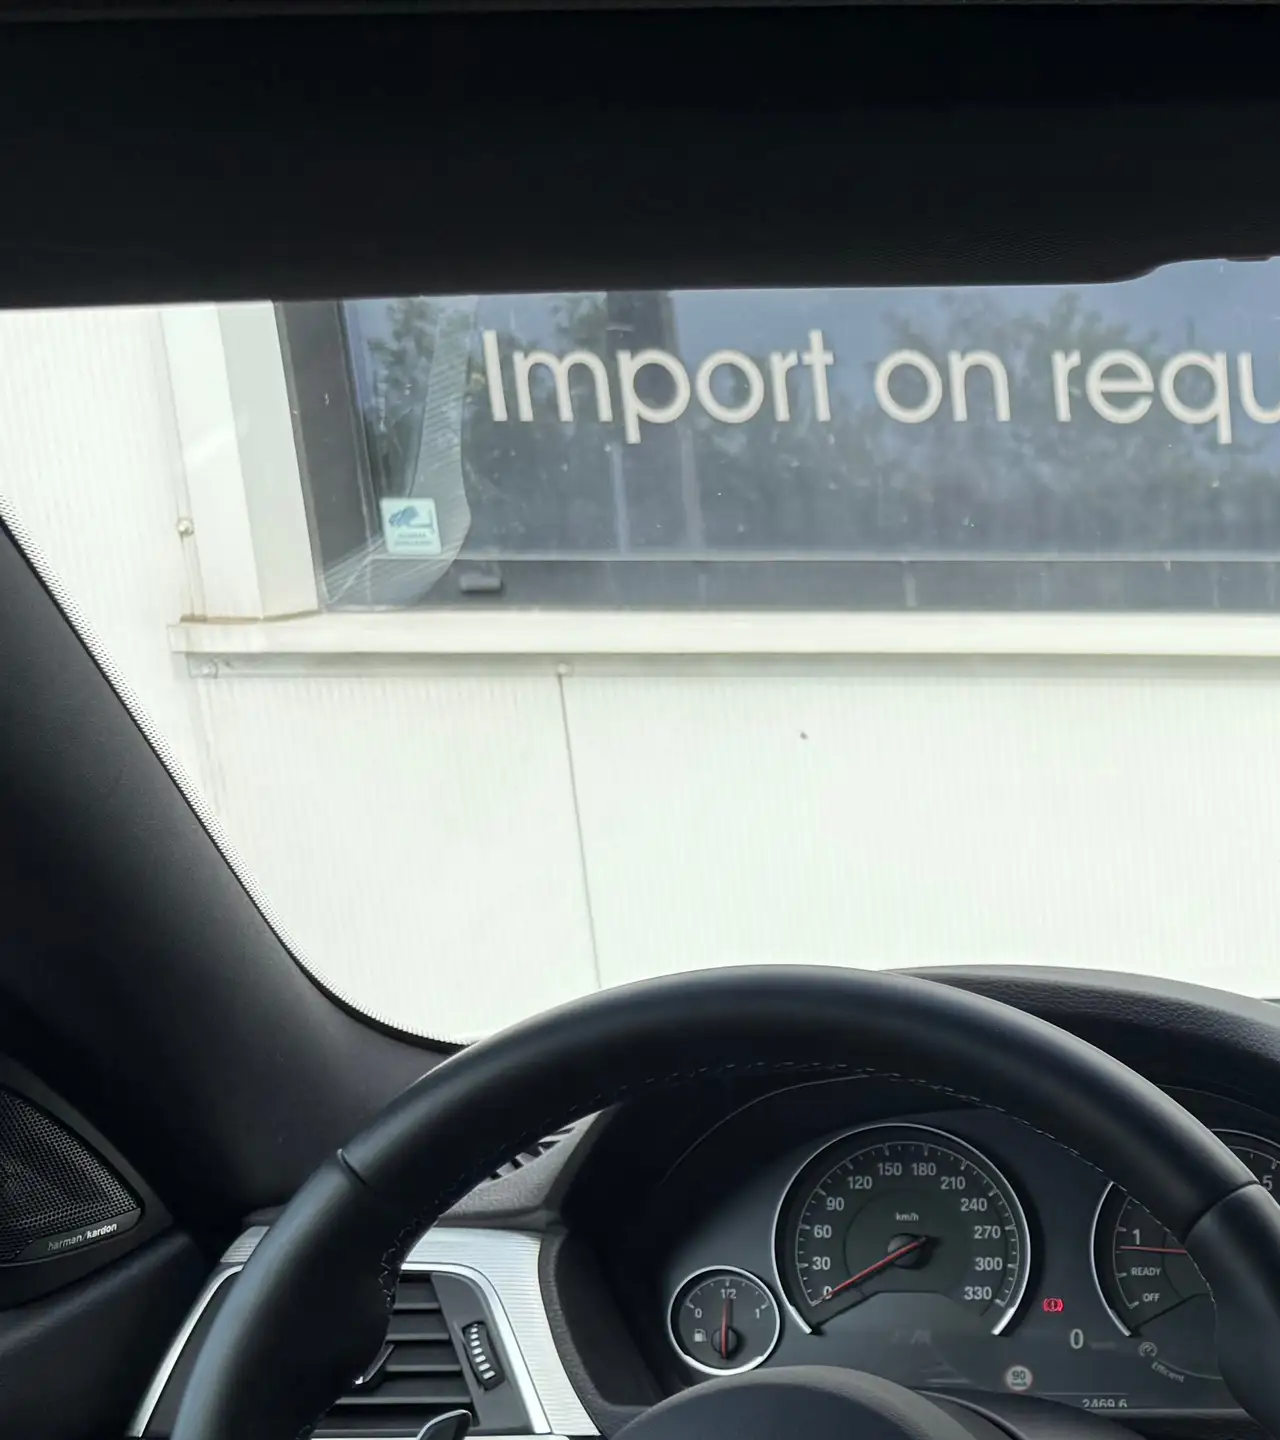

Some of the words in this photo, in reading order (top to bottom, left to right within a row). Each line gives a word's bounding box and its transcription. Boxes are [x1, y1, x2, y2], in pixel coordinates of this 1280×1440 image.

[481, 329, 835, 443] Import
[874, 350, 1011, 426] on
[877, 1162, 903, 1177] 150
[911, 1162, 937, 1177] 180
[847, 1176, 873, 1191] 120
[940, 1176, 966, 1191] 210
[1262, 1175, 1273, 1191] 5
[826, 1197, 845, 1212] 90
[960, 1197, 988, 1212] 240
[895, 1212, 920, 1223] km/h
[813, 1224, 832, 1240] 60
[973, 1224, 1001, 1240] 270
[1131, 1229, 1141, 1245] 1
[812, 1256, 832, 1272] 30
[975, 1256, 1004, 1272] 300
[1131, 1267, 1162, 1277] READY
[823, 1285, 833, 1300] 0
[964, 1286, 993, 1301] 330
[1142, 1293, 1160, 1303] OFF
[694, 1308, 703, 1320] 0
[754, 1308, 761, 1320] 1
[1070, 1328, 1084, 1349] 0
[1012, 1370, 1026, 1381] 90
